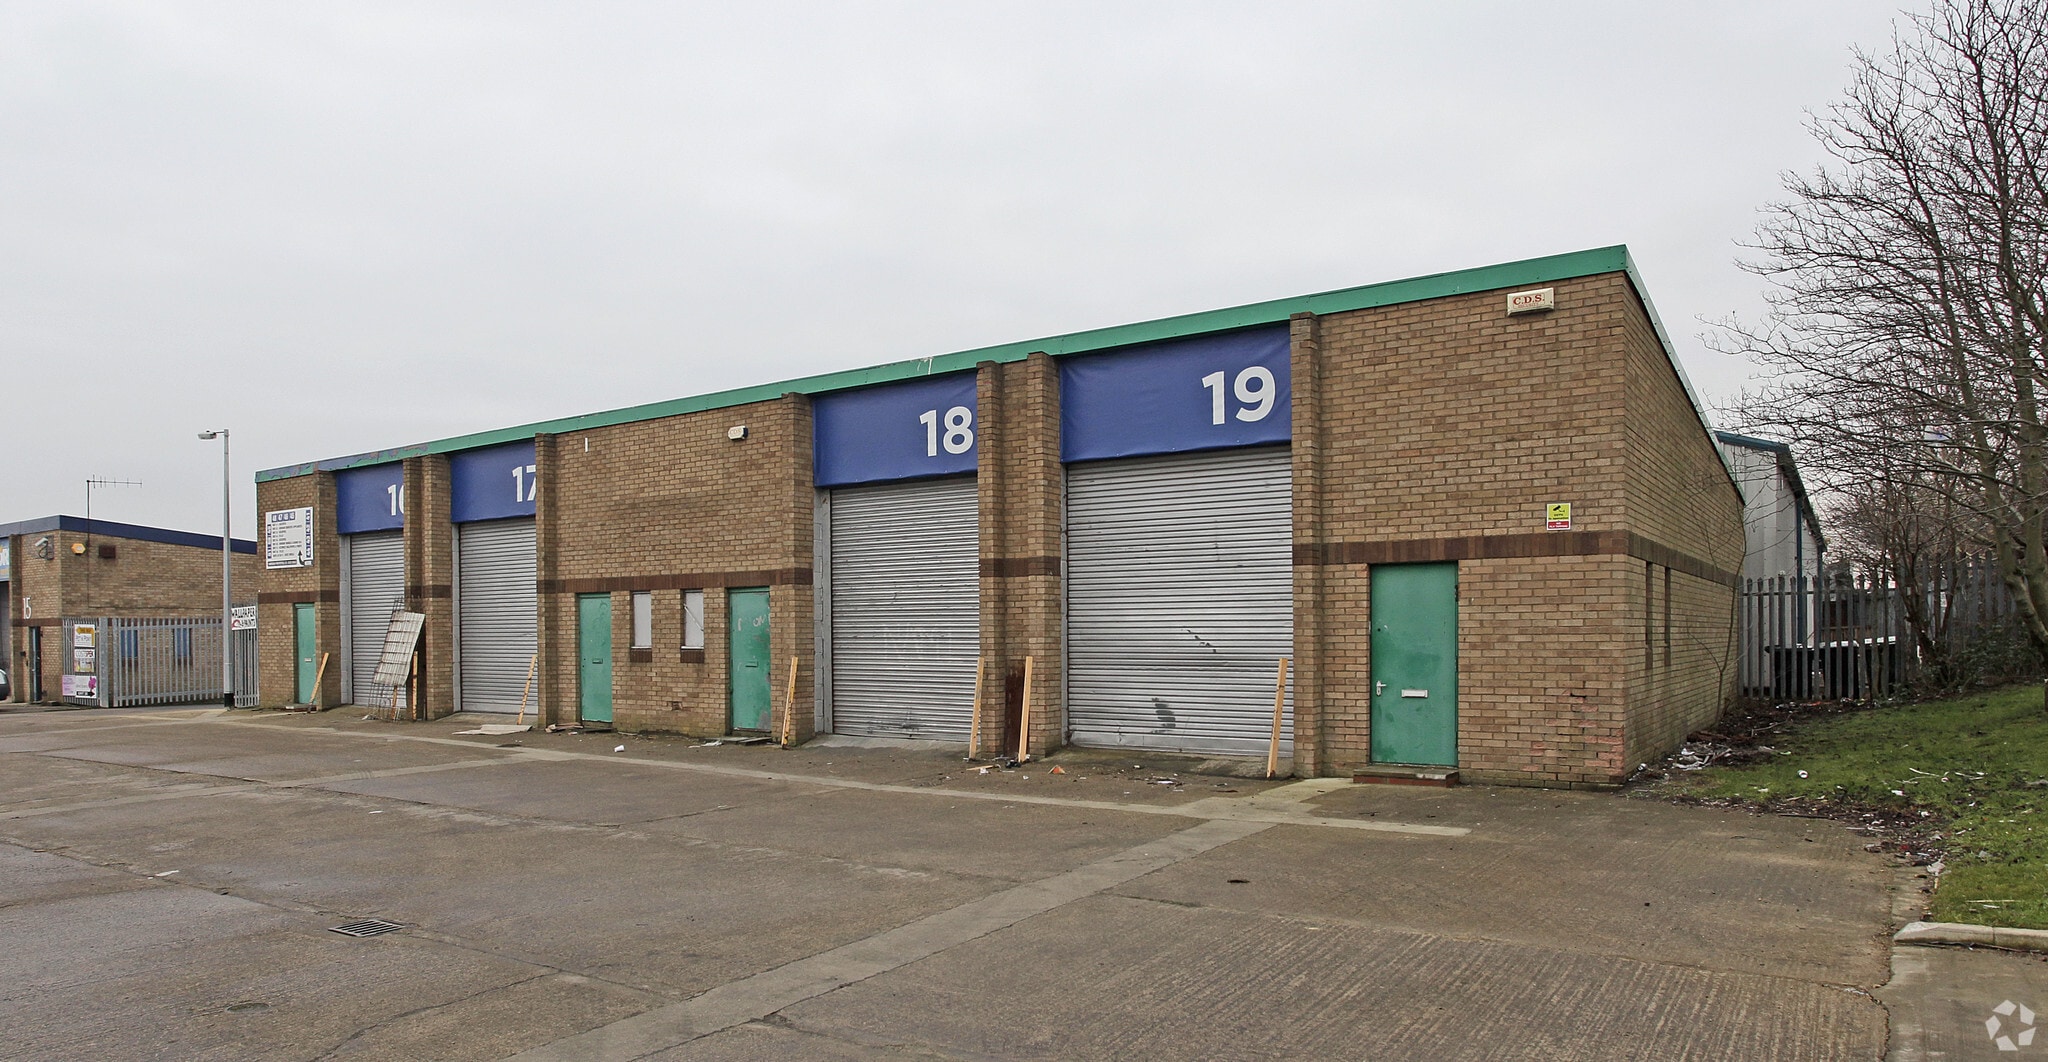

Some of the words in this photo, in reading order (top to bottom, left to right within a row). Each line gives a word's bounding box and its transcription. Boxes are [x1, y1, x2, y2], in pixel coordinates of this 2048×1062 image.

[1513, 294, 1545, 305] C.D.S.
[1202, 366, 1276, 425] 19
[919, 406, 974, 457] 18
[512, 465, 536, 502] 17
[23, 597, 32, 619] 15
